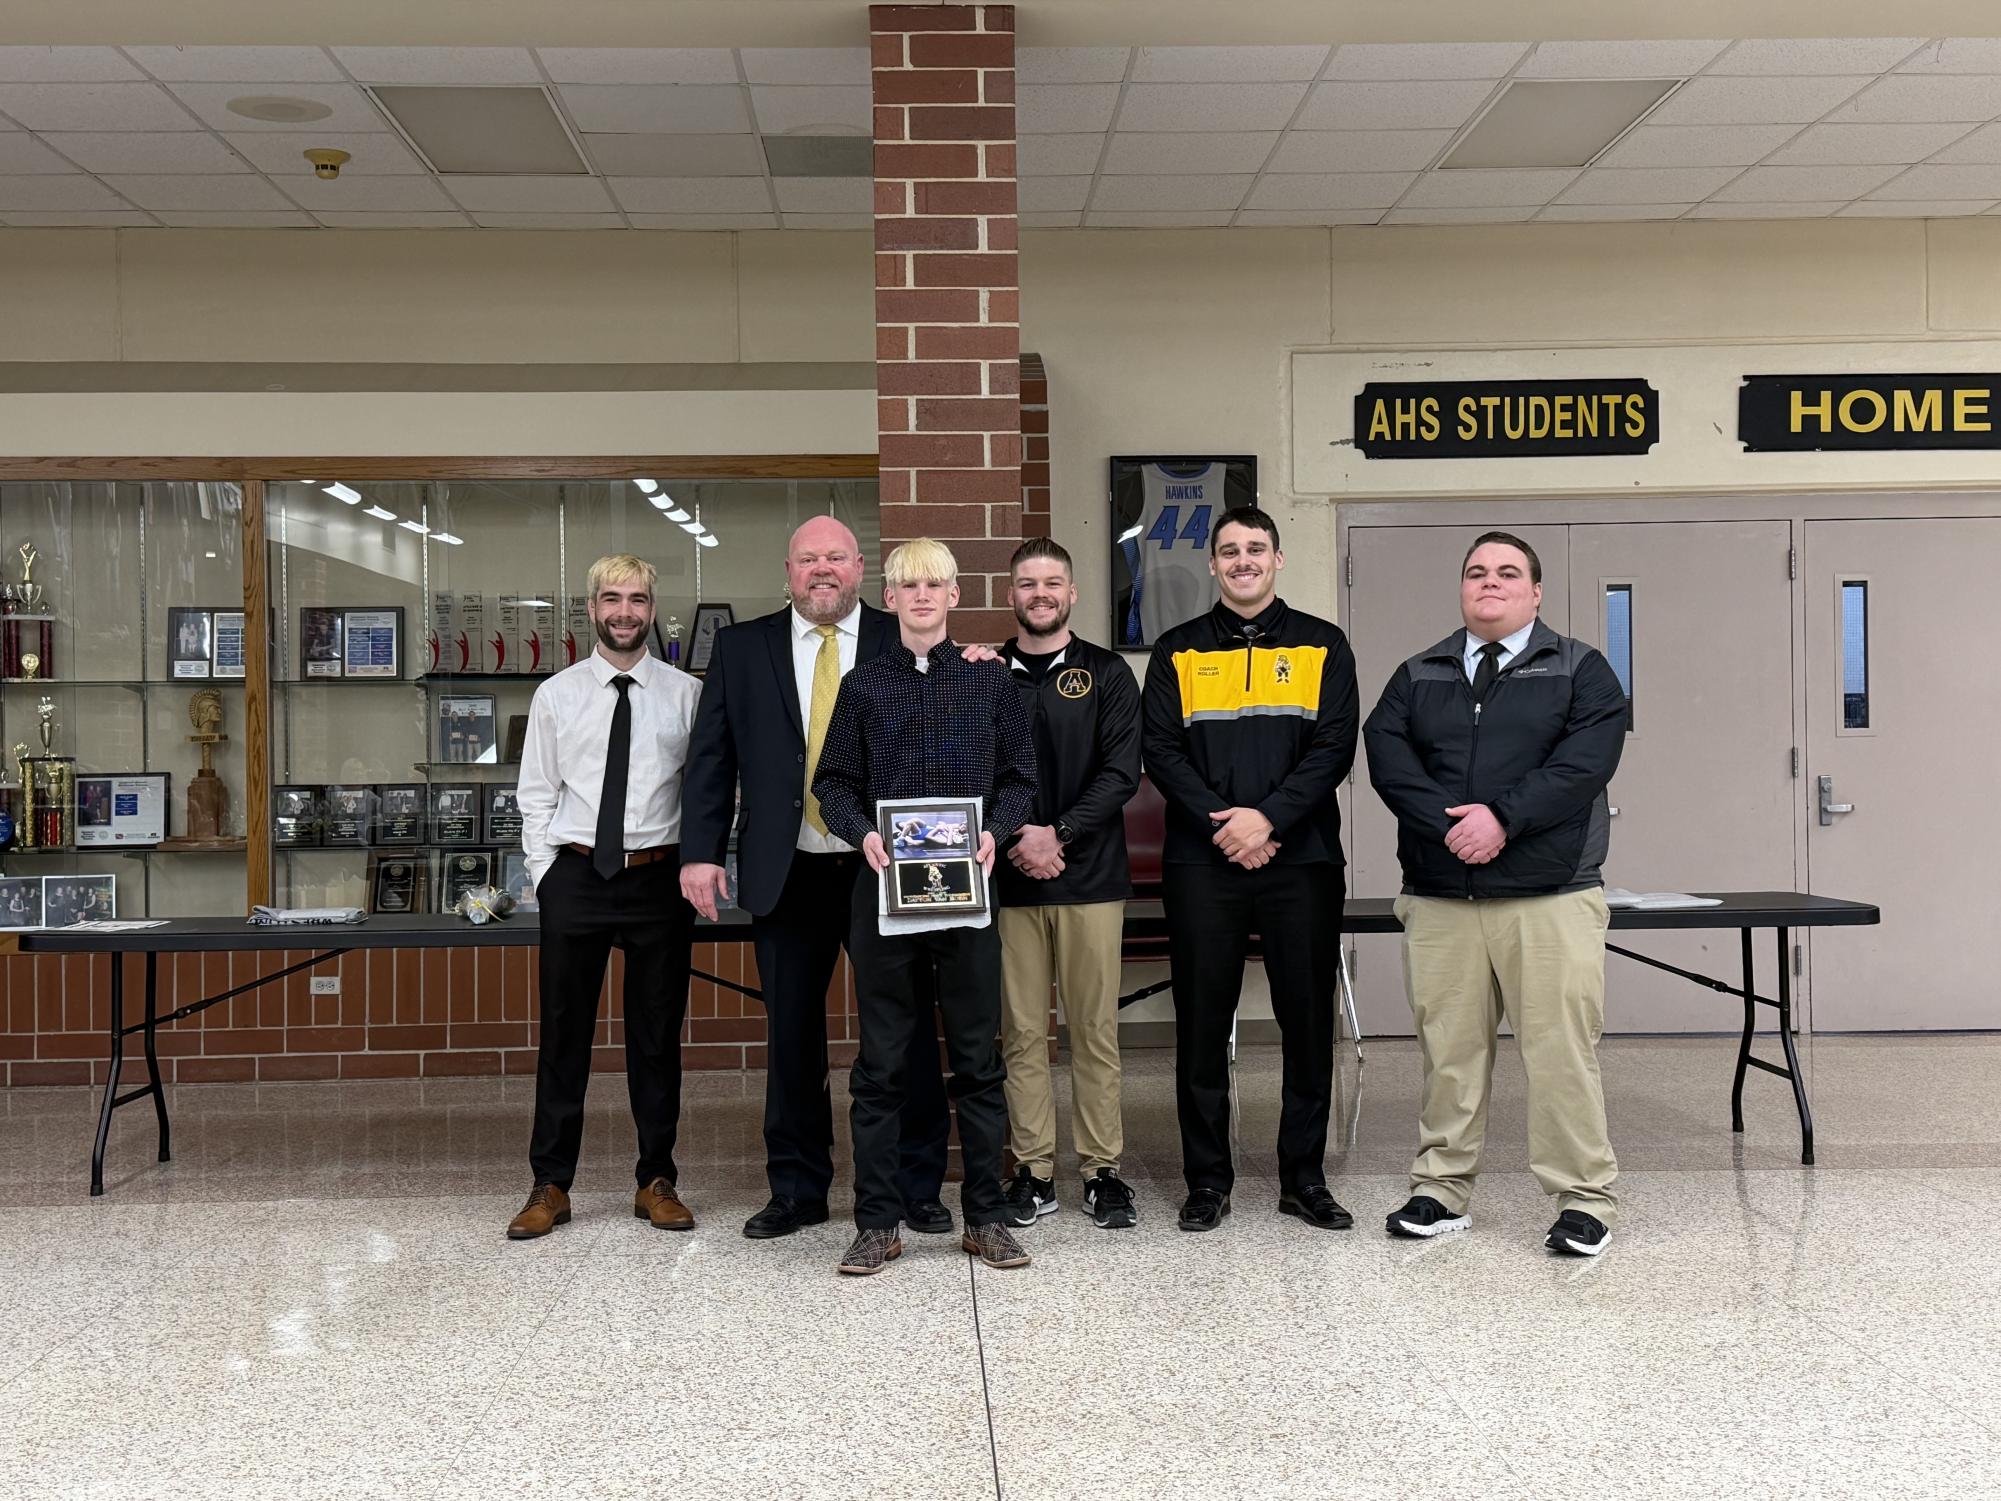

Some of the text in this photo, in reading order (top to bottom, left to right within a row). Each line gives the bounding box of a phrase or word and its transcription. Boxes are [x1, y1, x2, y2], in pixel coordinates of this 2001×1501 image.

[1368, 394, 1645, 441] AHS STUDENTS
[1790, 389, 1992, 433] HOME
[1165, 485, 1204, 500] HAWKINS
[1146, 505, 1213, 549] 44
[1063, 671, 1088, 694] A
